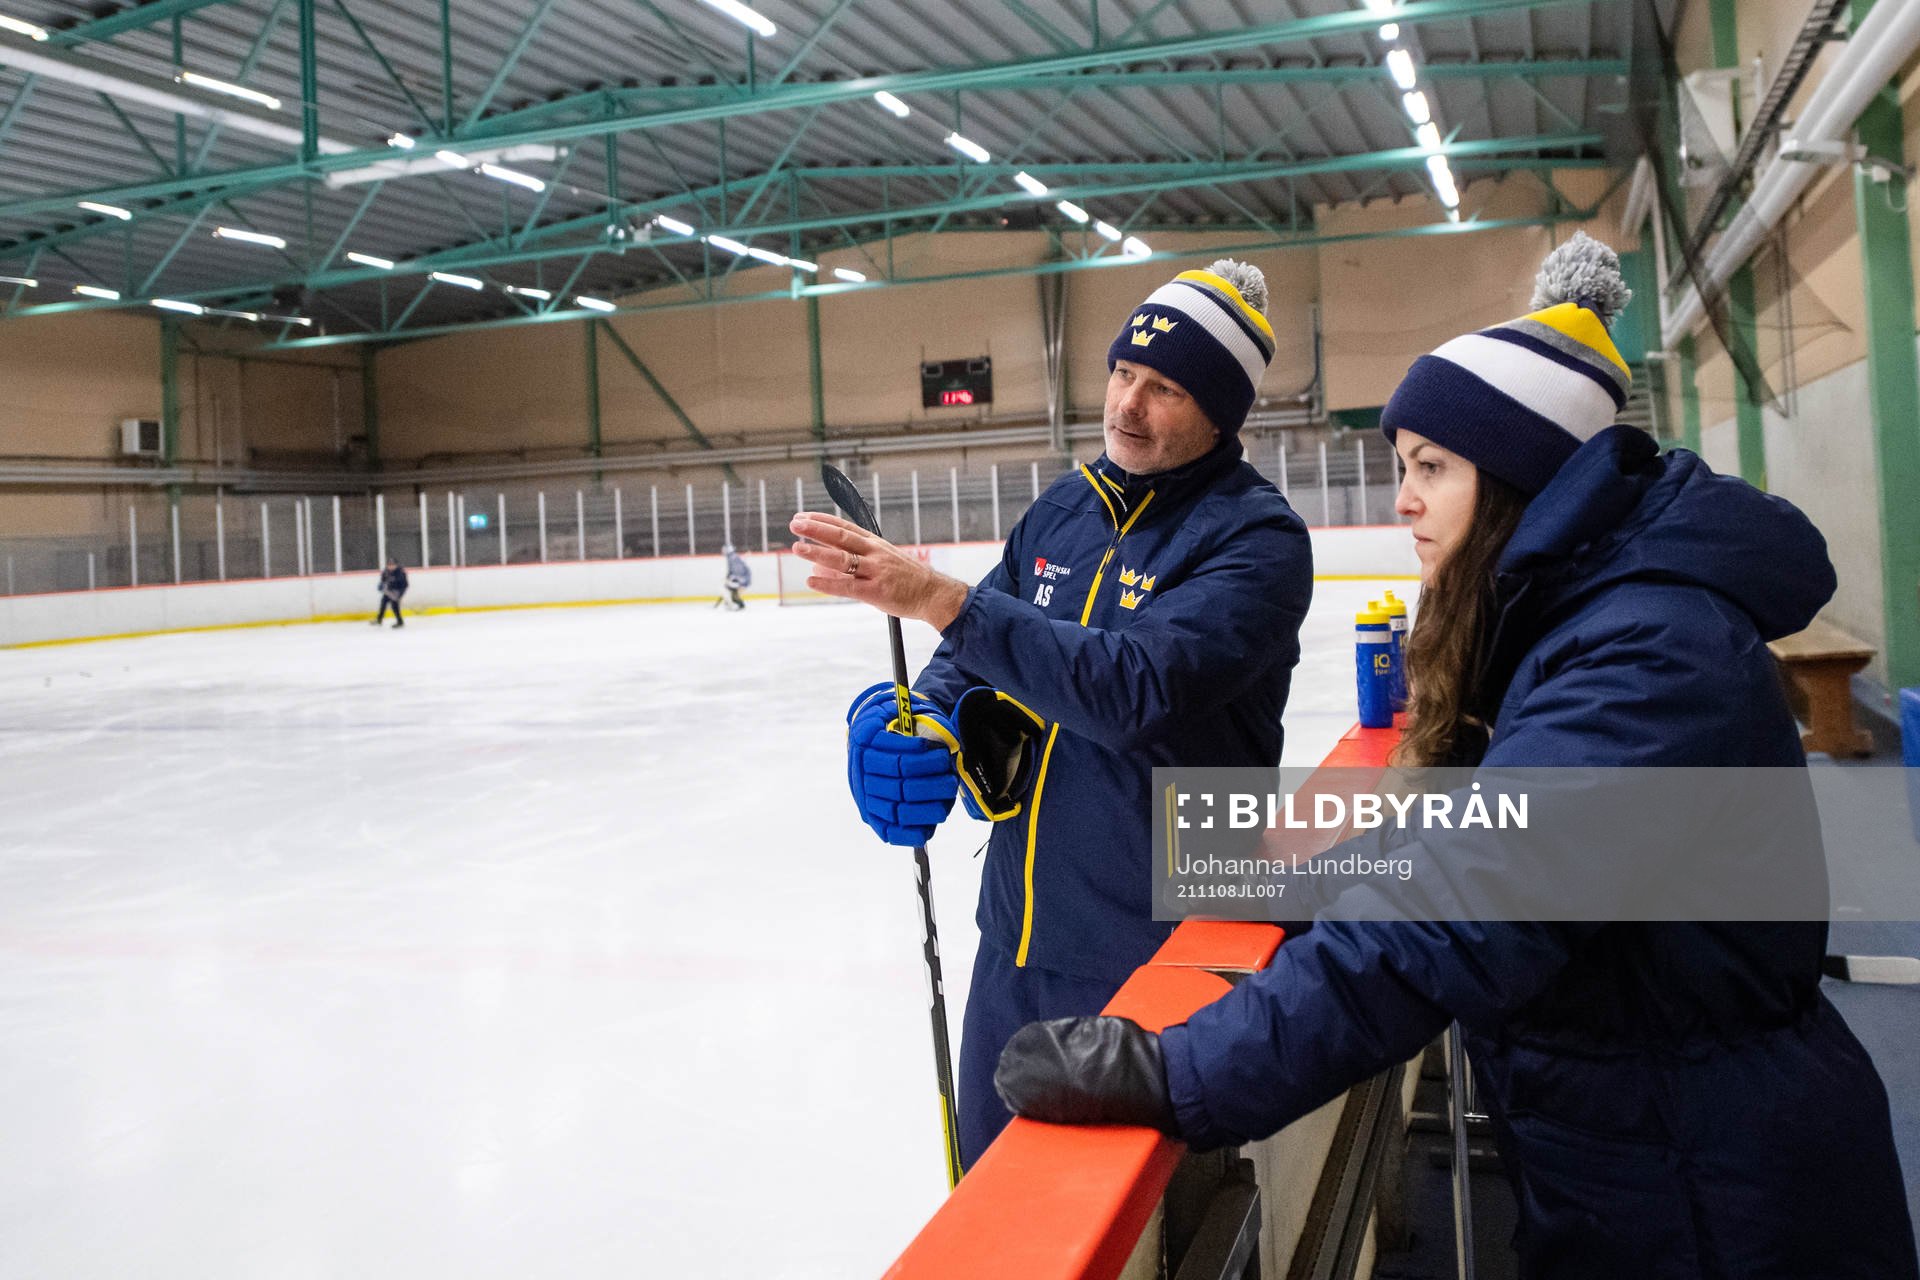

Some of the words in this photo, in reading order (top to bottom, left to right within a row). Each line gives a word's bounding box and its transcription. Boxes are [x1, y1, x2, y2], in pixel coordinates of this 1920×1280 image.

[1042, 571, 1057, 581] SPEL
[1044, 563, 1071, 576] SVENSKA
[1033, 583, 1054, 607] AS
